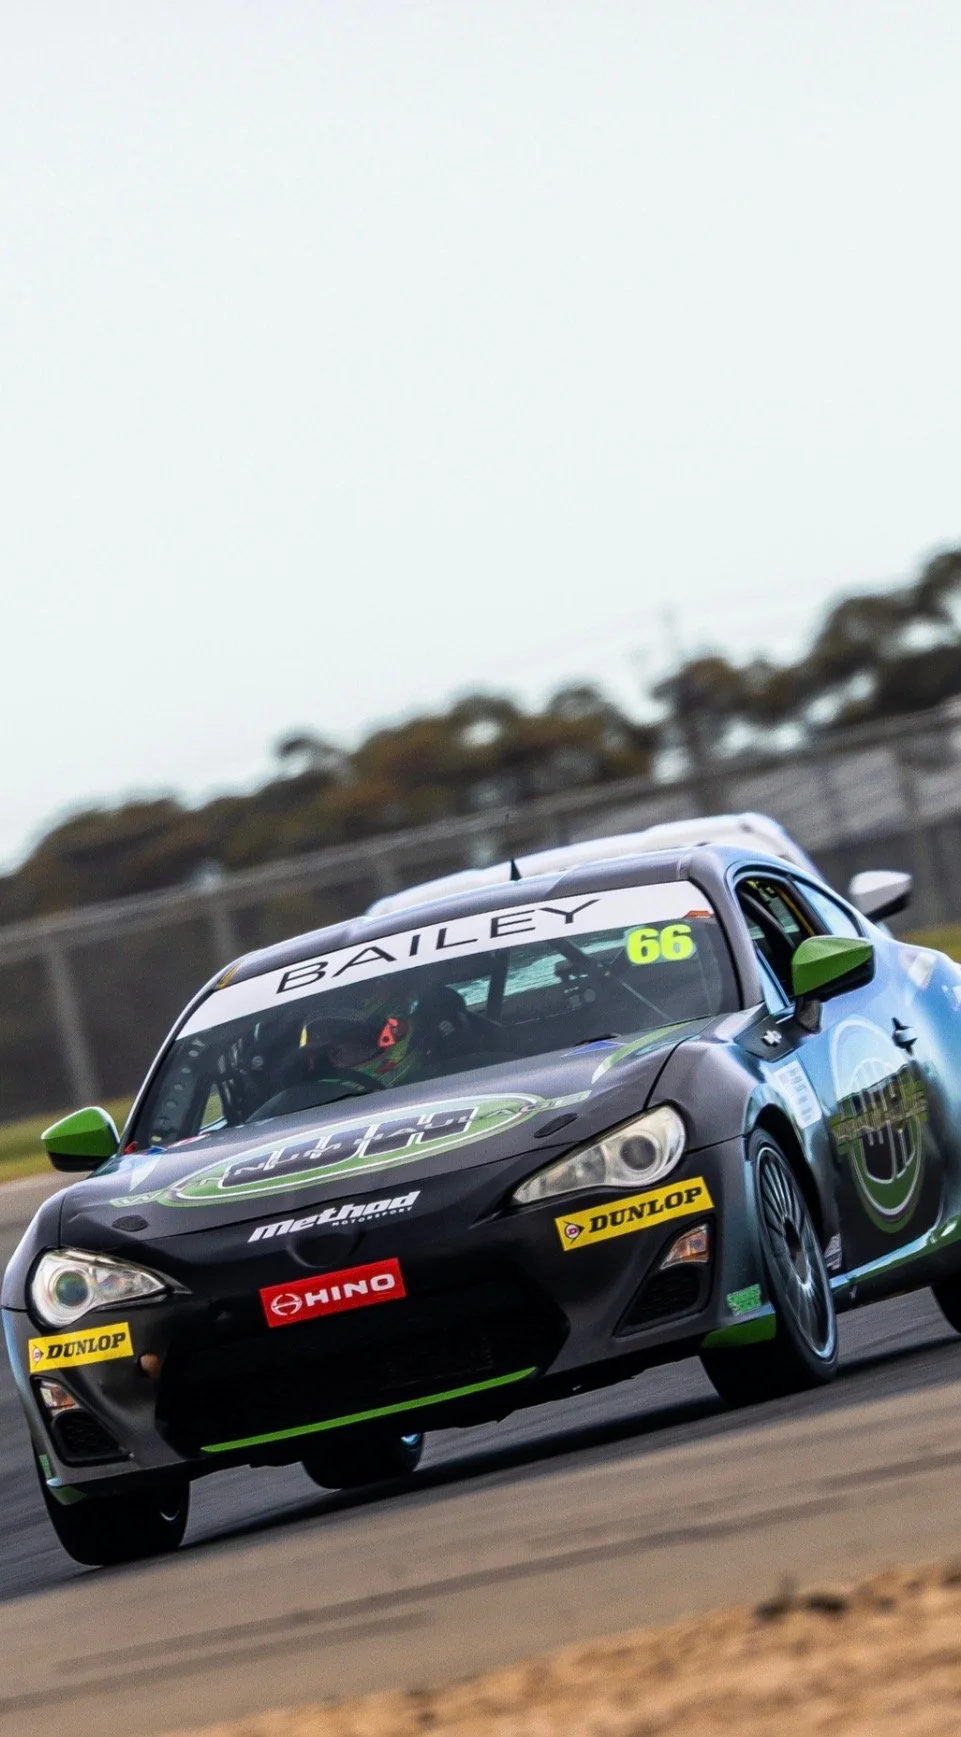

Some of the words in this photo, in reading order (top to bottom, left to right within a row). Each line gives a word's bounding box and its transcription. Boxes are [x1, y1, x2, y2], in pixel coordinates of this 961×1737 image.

[276, 898, 600, 994] BAILEY
[627, 924, 694, 965] 66
[247, 1190, 421, 1243] method
[332, 1206, 412, 1227] MOTORSPORT
[589, 1187, 702, 1233] DUNLOP
[304, 1273, 396, 1307] HINO
[46, 1332, 126, 1360] DUNLOP
